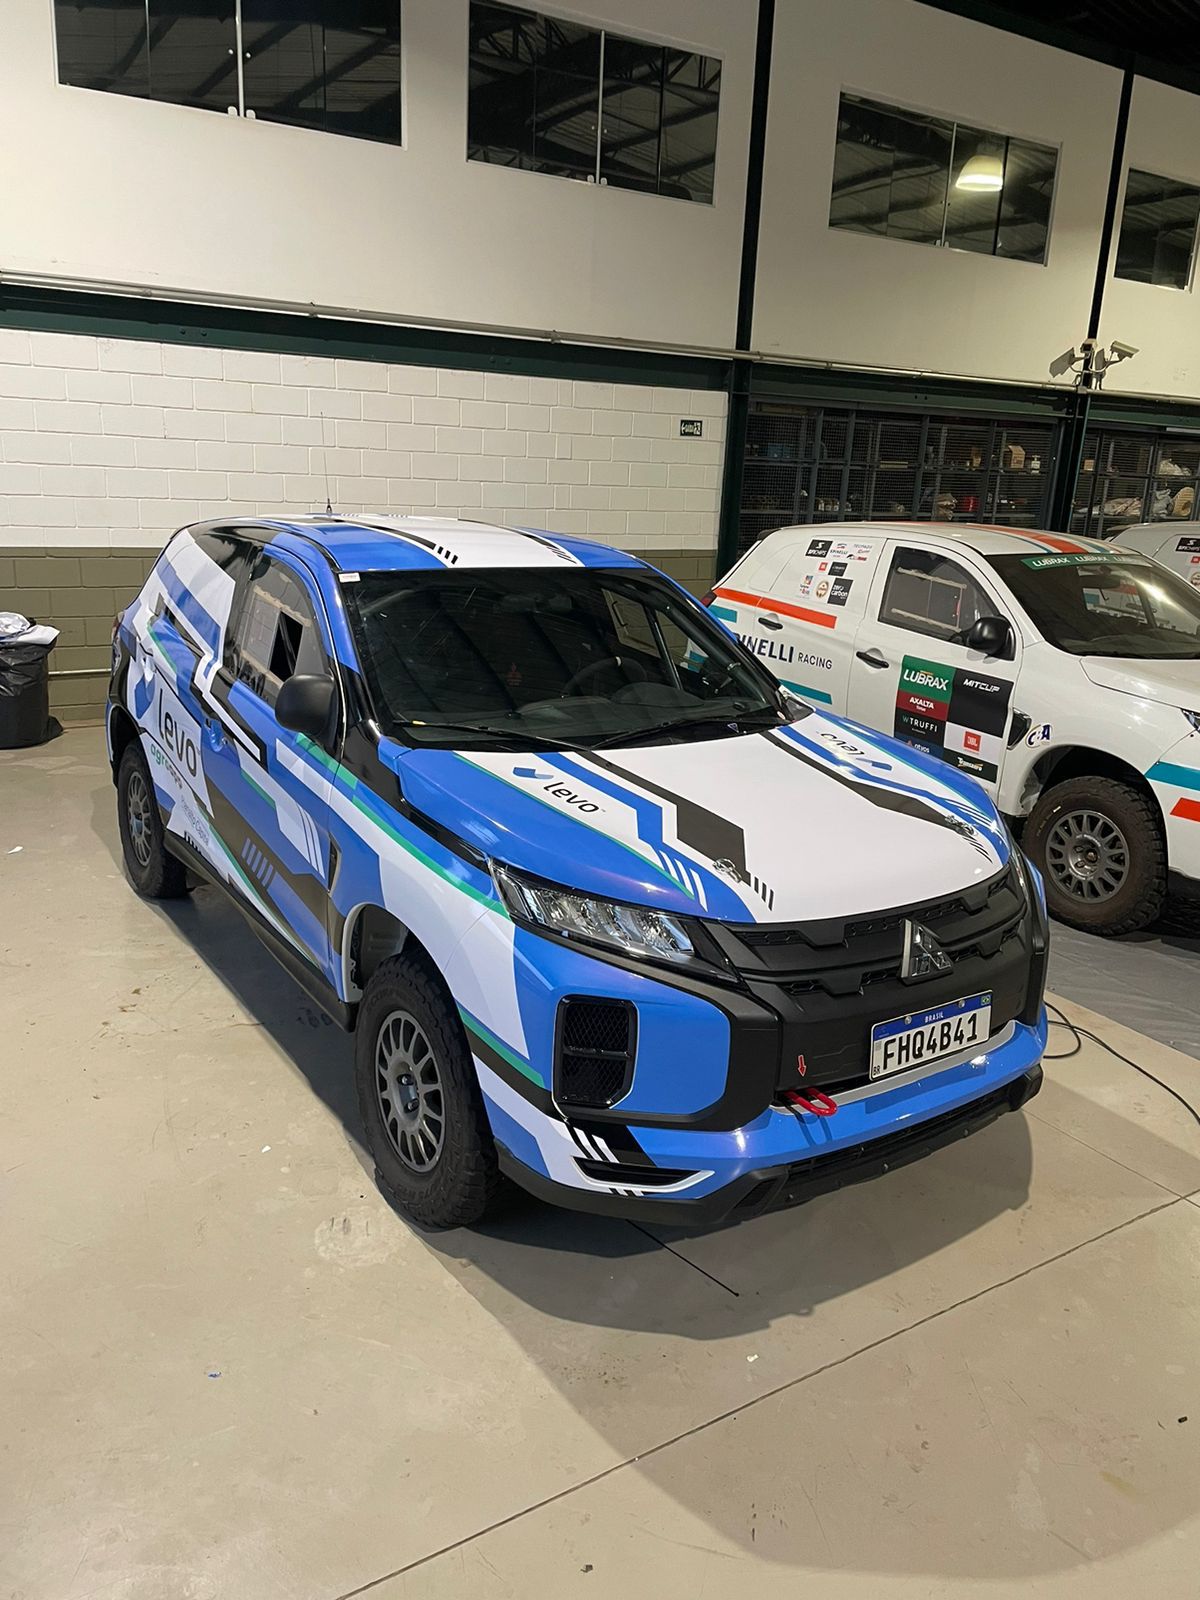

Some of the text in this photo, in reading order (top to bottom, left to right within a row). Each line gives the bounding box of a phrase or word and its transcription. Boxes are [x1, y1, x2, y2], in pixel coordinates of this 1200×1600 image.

[1032, 556, 1071, 567] LUBRAX
[798, 652, 832, 669] RACING
[903, 669, 950, 691] LUBRAX
[909, 697, 934, 709] AXALTA
[910, 717, 937, 731] TRUFFI
[158, 688, 197, 778] levo
[543, 781, 600, 813] levo
[925, 1012, 943, 1022] BRASIL
[883, 1013, 977, 1070] FHQ4B41
